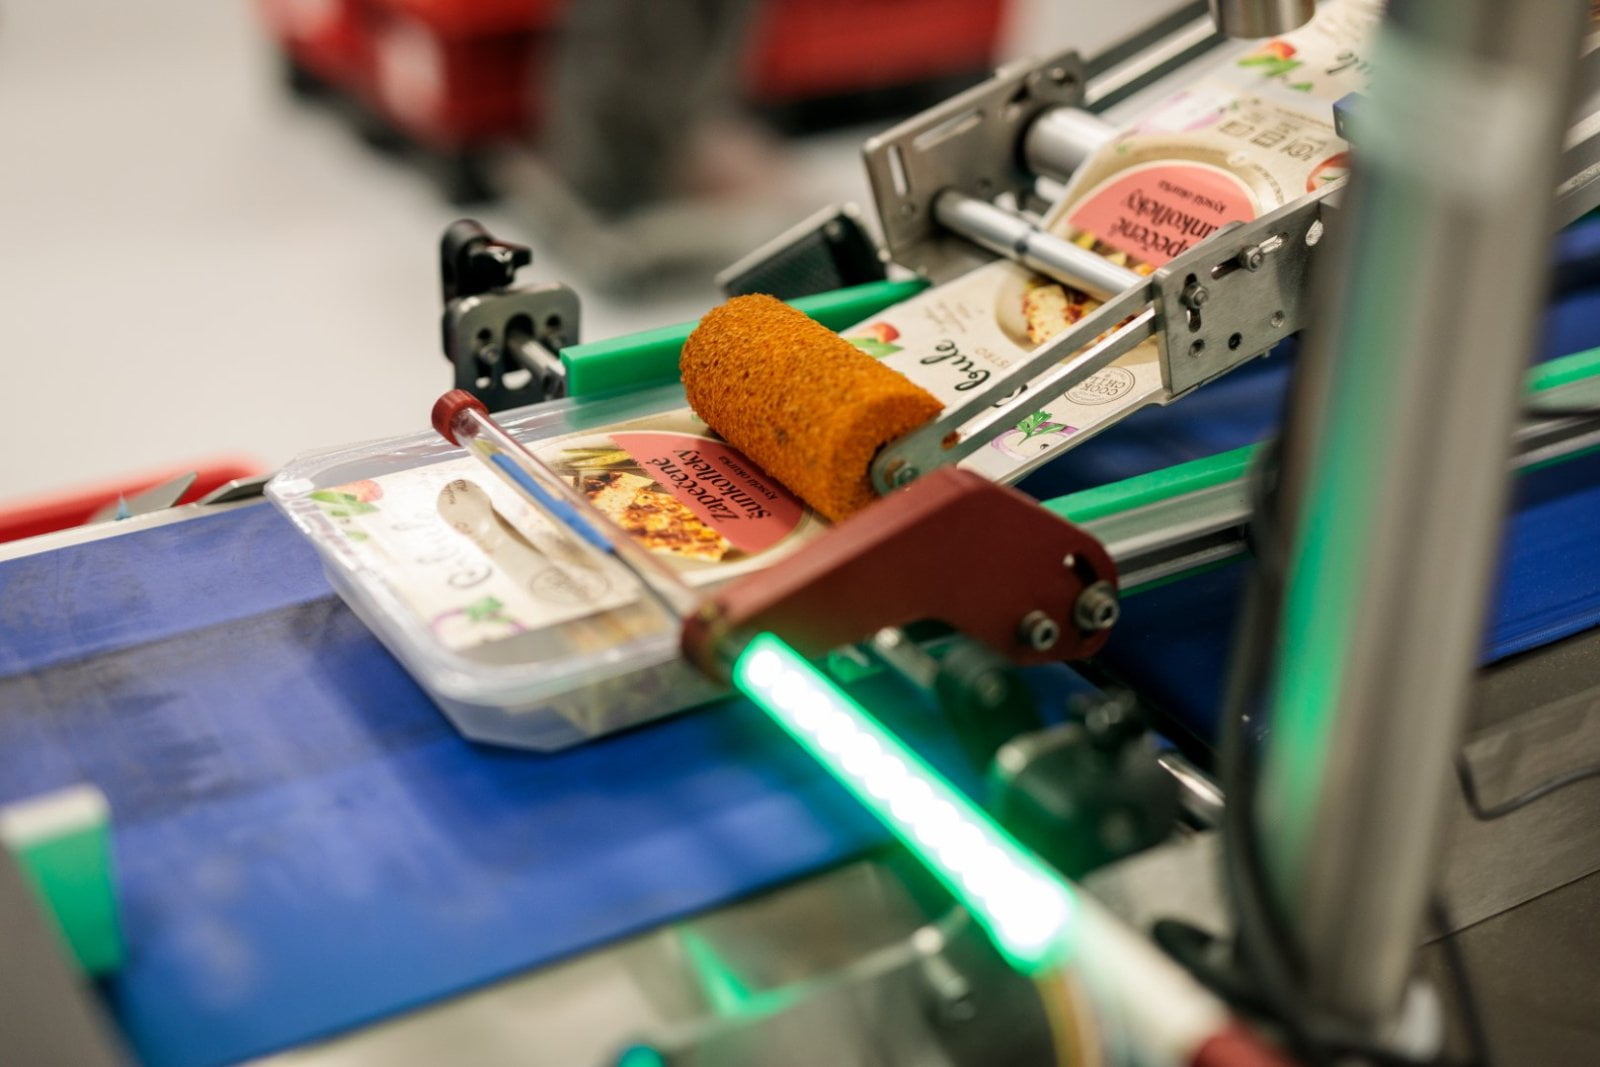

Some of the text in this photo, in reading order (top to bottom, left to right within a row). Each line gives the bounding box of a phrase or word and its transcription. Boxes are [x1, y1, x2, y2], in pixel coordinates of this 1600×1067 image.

[1080, 383, 1119, 396] COOK
[1088, 375, 1126, 389] CHIL
[645, 456, 740, 523] Zapečené
[672, 449, 772, 520] šunkofleky
